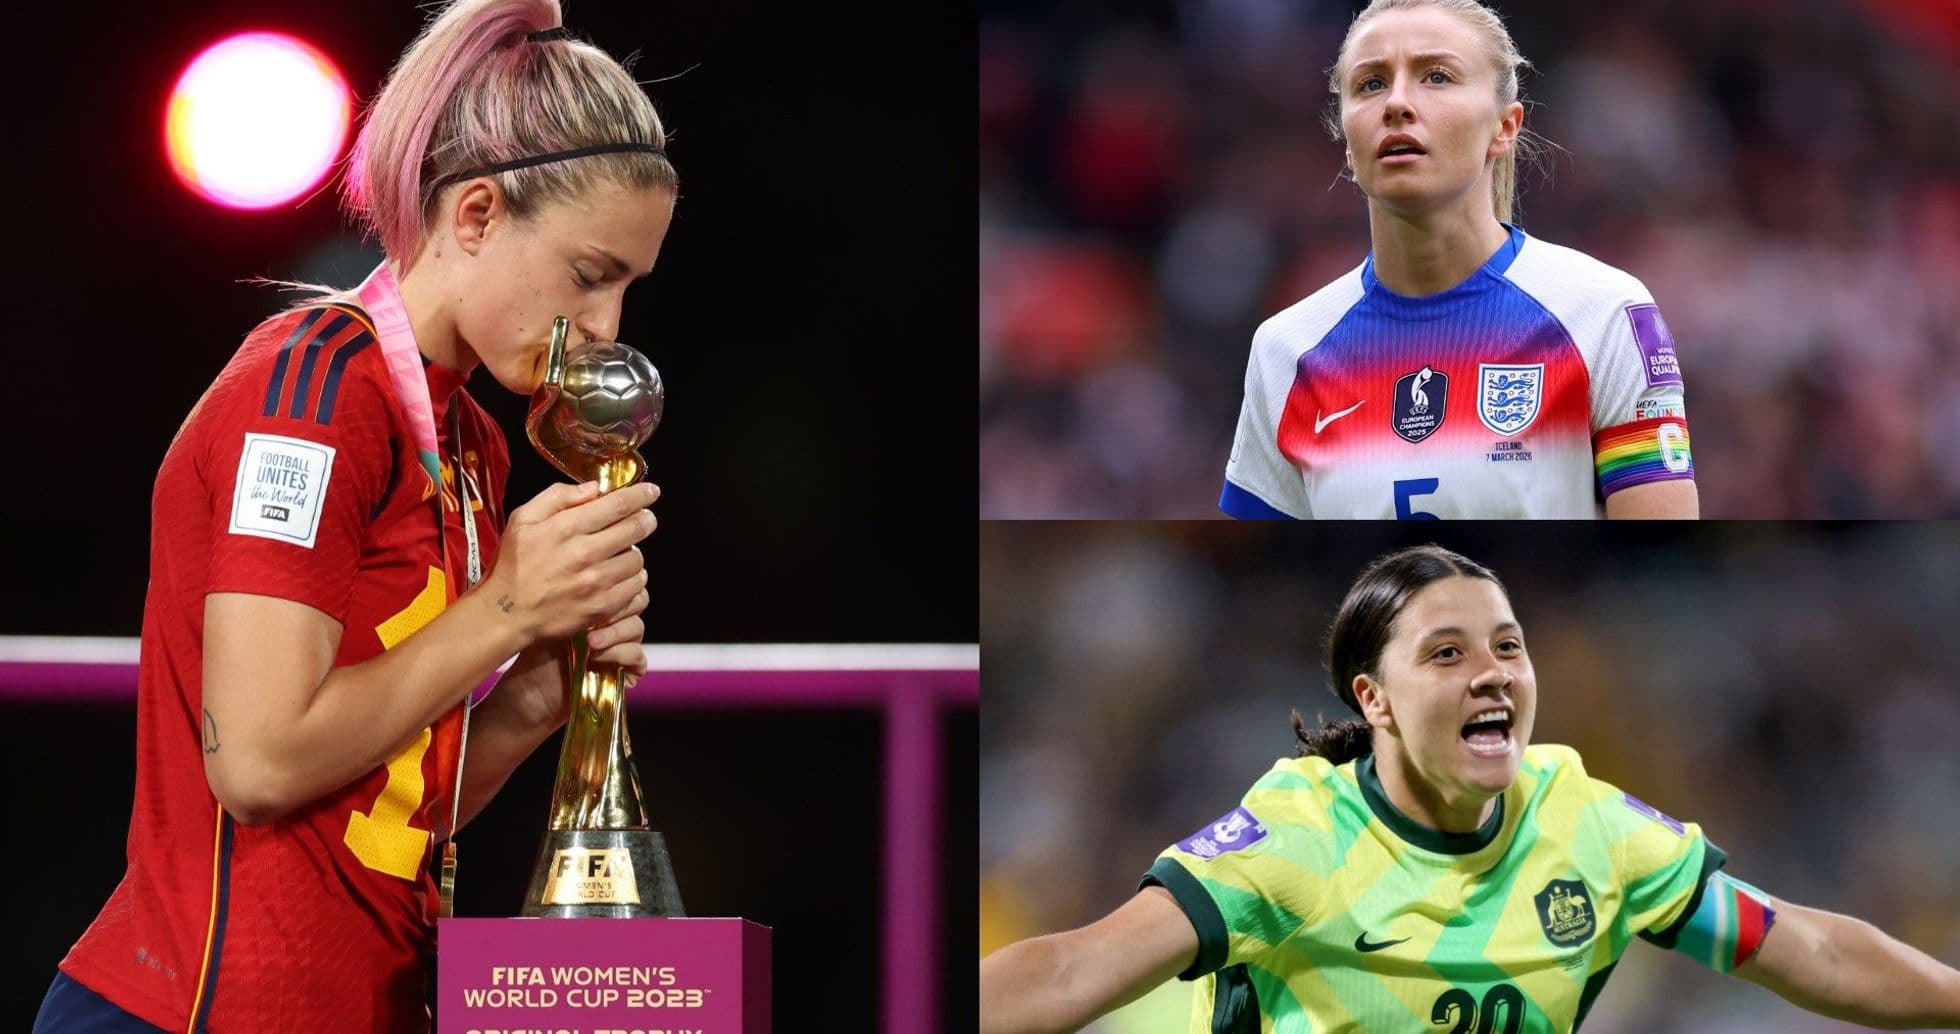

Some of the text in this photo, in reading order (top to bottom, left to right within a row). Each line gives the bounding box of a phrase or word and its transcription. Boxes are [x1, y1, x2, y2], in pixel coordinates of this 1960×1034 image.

[1637, 400, 1657, 409] UEFA
[1400, 421, 1435, 430] CHAMPIONS
[1401, 415, 1434, 424] EUROPEAN
[1408, 429, 1426, 437] 2025
[1495, 441, 1523, 451] ICELAND
[1656, 423, 1690, 473] C
[260, 452, 310, 472] FOOTBALL
[1486, 451, 1533, 462] 7 MARCH 2026
[257, 466, 308, 490] UNITES
[251, 485, 308, 509] the World
[262, 506, 287, 520] FIFA
[492, 967, 676, 985] FIFA WOMEN'S
[463, 989, 558, 1008] WORLD
[566, 989, 619, 1008] CUP
[1431, 983, 1526, 1034] 20
